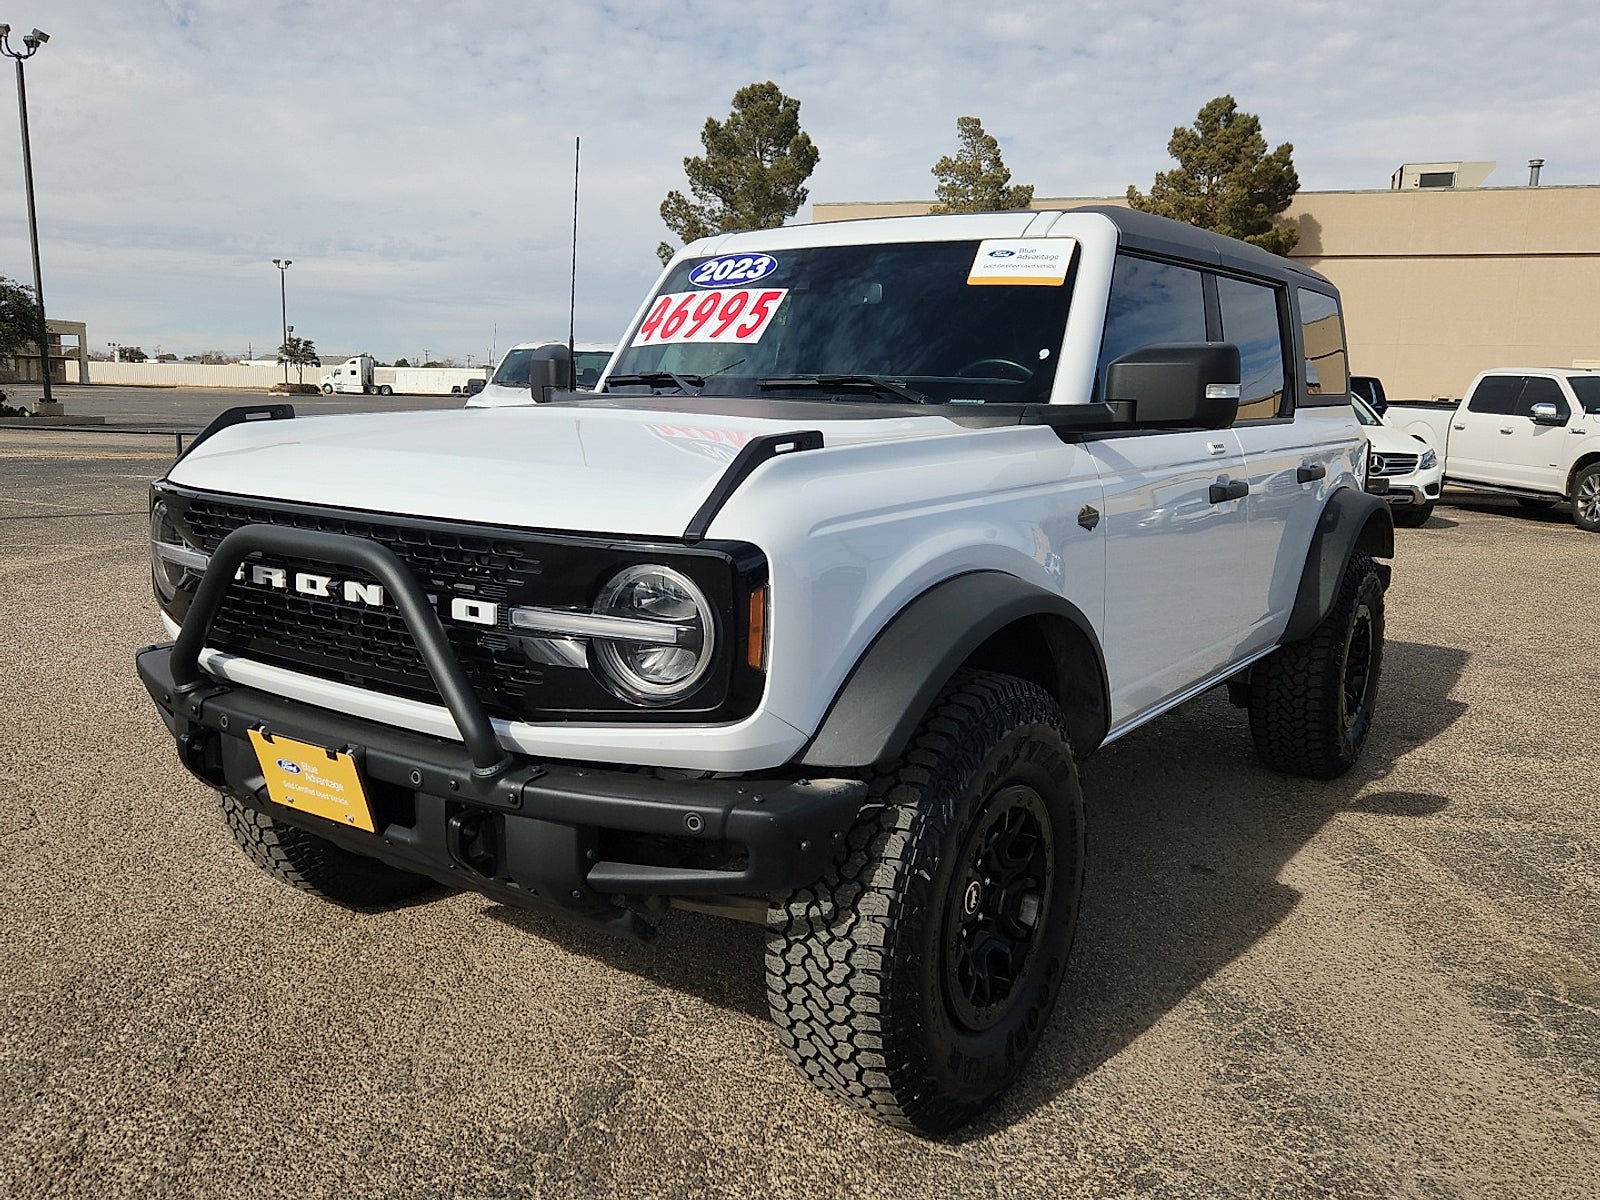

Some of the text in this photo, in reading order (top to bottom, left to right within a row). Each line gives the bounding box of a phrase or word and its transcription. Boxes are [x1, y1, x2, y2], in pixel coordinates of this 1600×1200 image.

[693, 256, 771, 283] 2023
[641, 291, 782, 342] 46995
[234, 561, 498, 626] RONO
[301, 761, 318, 775] Blue
[304, 772, 345, 792] Advantage
